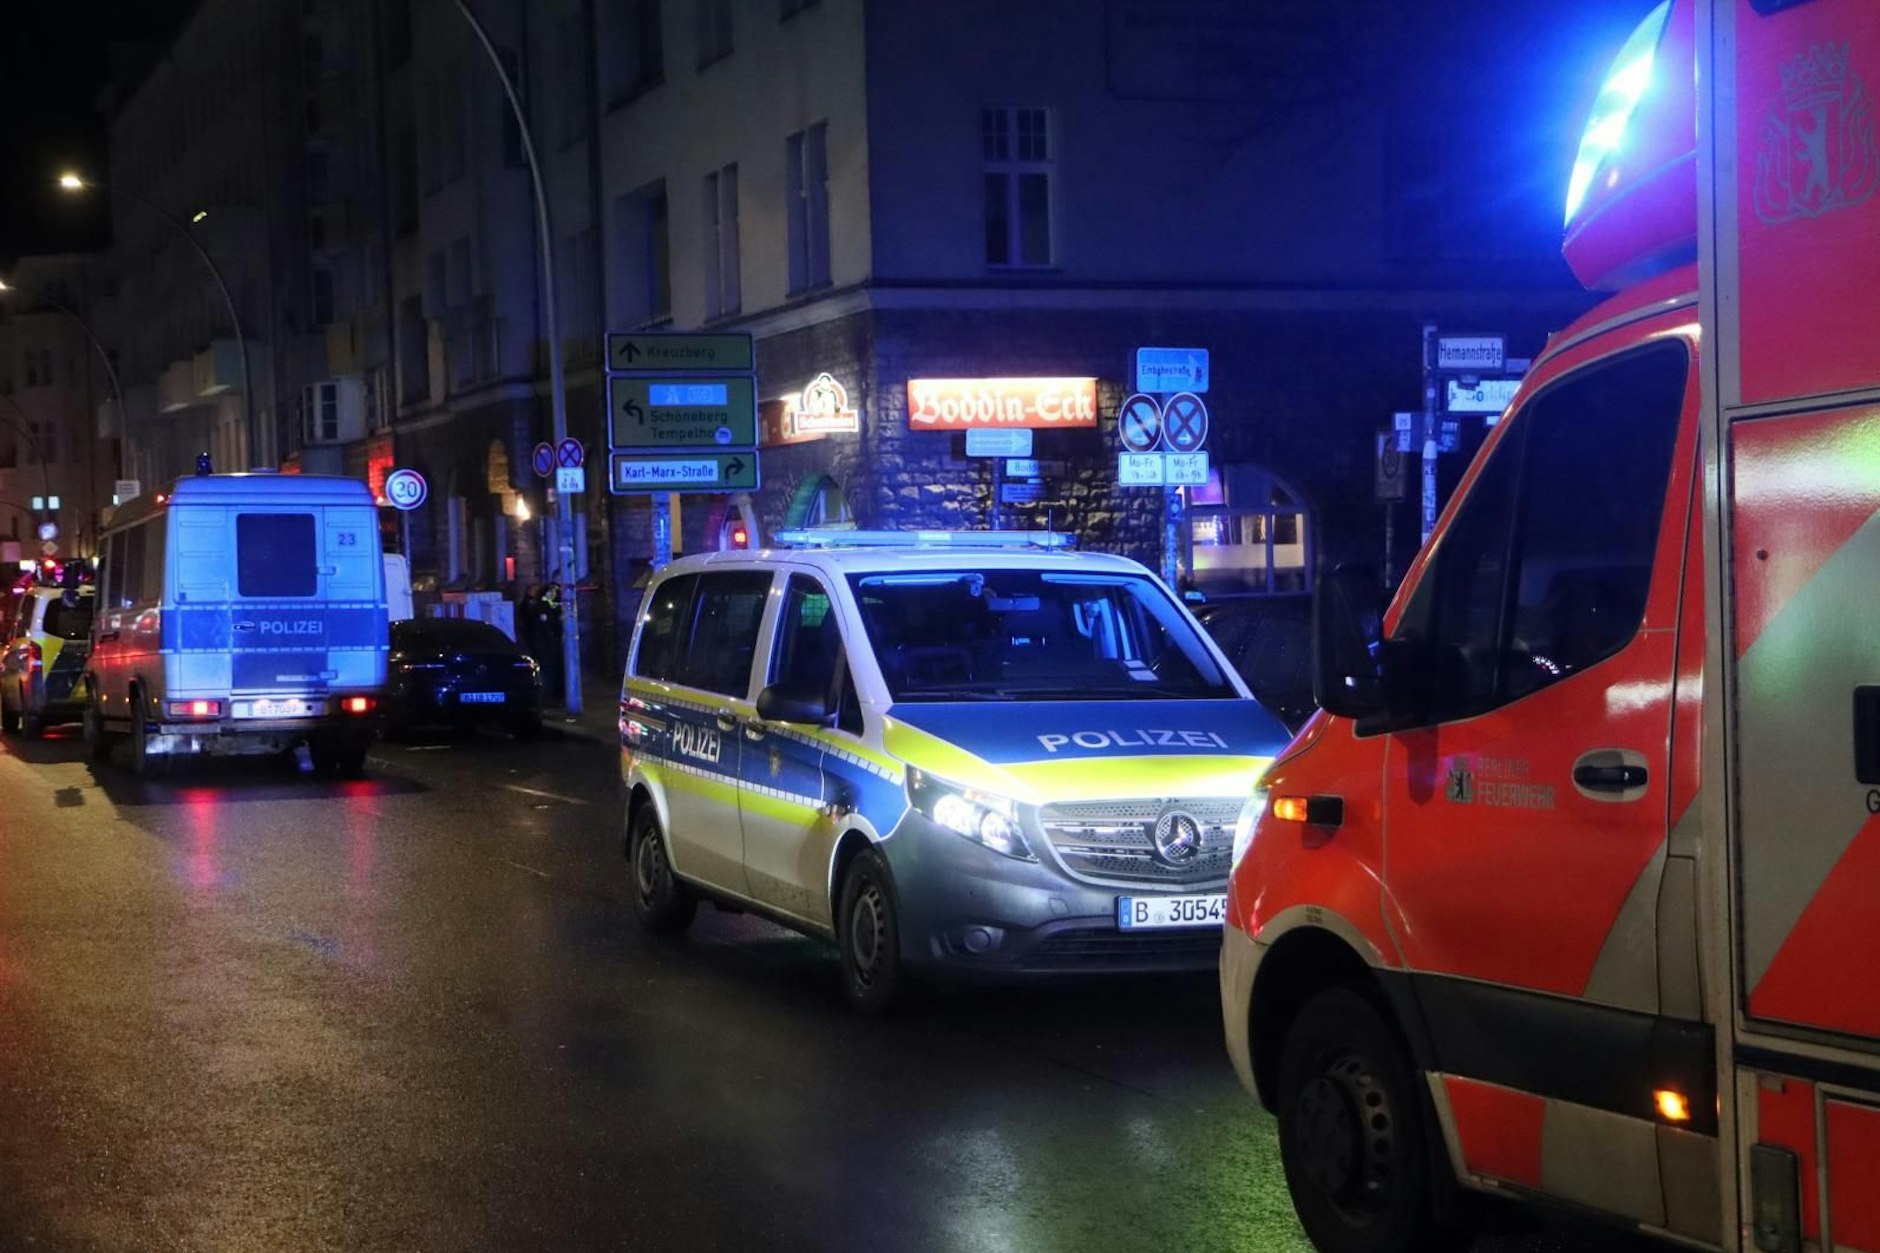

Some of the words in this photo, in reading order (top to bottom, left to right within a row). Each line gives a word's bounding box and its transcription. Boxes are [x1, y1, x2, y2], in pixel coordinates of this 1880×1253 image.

[647, 346, 716, 360] Kreuzberg
[1439, 342, 1502, 364] Hermannstraße
[911, 382, 1094, 424] Boddin-Eck
[650, 410, 728, 425] Schöneberg
[650, 427, 717, 441] Tempelho
[625, 465, 714, 479] Karl-Marx-Straße
[395, 481, 418, 498] 30
[338, 533, 356, 546] 23
[260, 621, 323, 635] POLIZEI
[672, 720, 721, 763] POLIZEI
[1036, 729, 1229, 752] POLIZEI
[1478, 757, 1529, 781] BERLINER
[1478, 781, 1555, 810] FEUERWEHR
[1136, 901, 1149, 923] B
